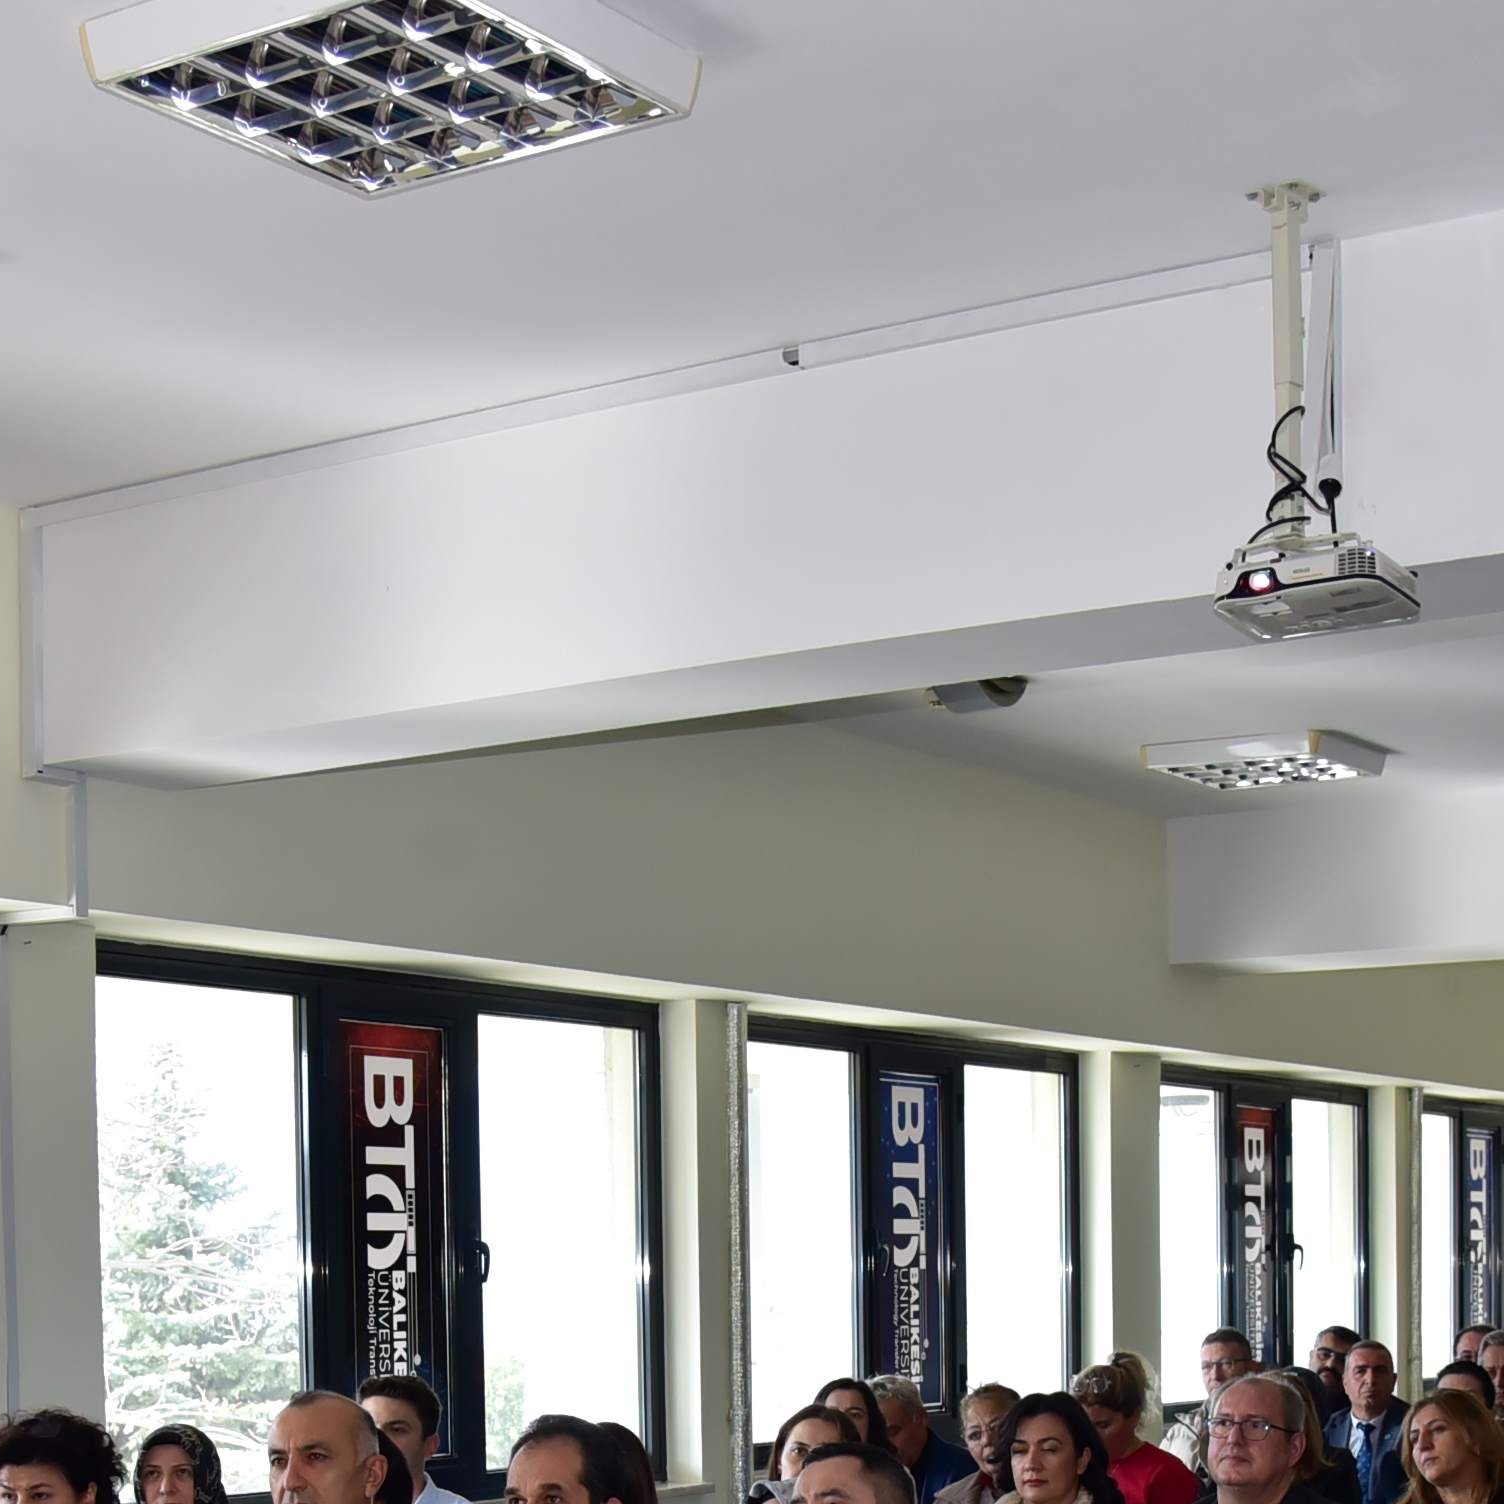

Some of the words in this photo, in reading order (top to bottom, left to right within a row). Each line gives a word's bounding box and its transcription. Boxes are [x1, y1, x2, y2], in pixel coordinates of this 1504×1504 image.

[367, 1270, 376, 1334] Teknoloji
[377, 1271, 393, 1378] ÜNİVERSİ
[392, 1270, 408, 1377] BALIKE
[899, 1268, 910, 1378] UNIVERSI
[909, 1267, 923, 1390] BALIKESİ
[369, 1335, 377, 1377] Trans
